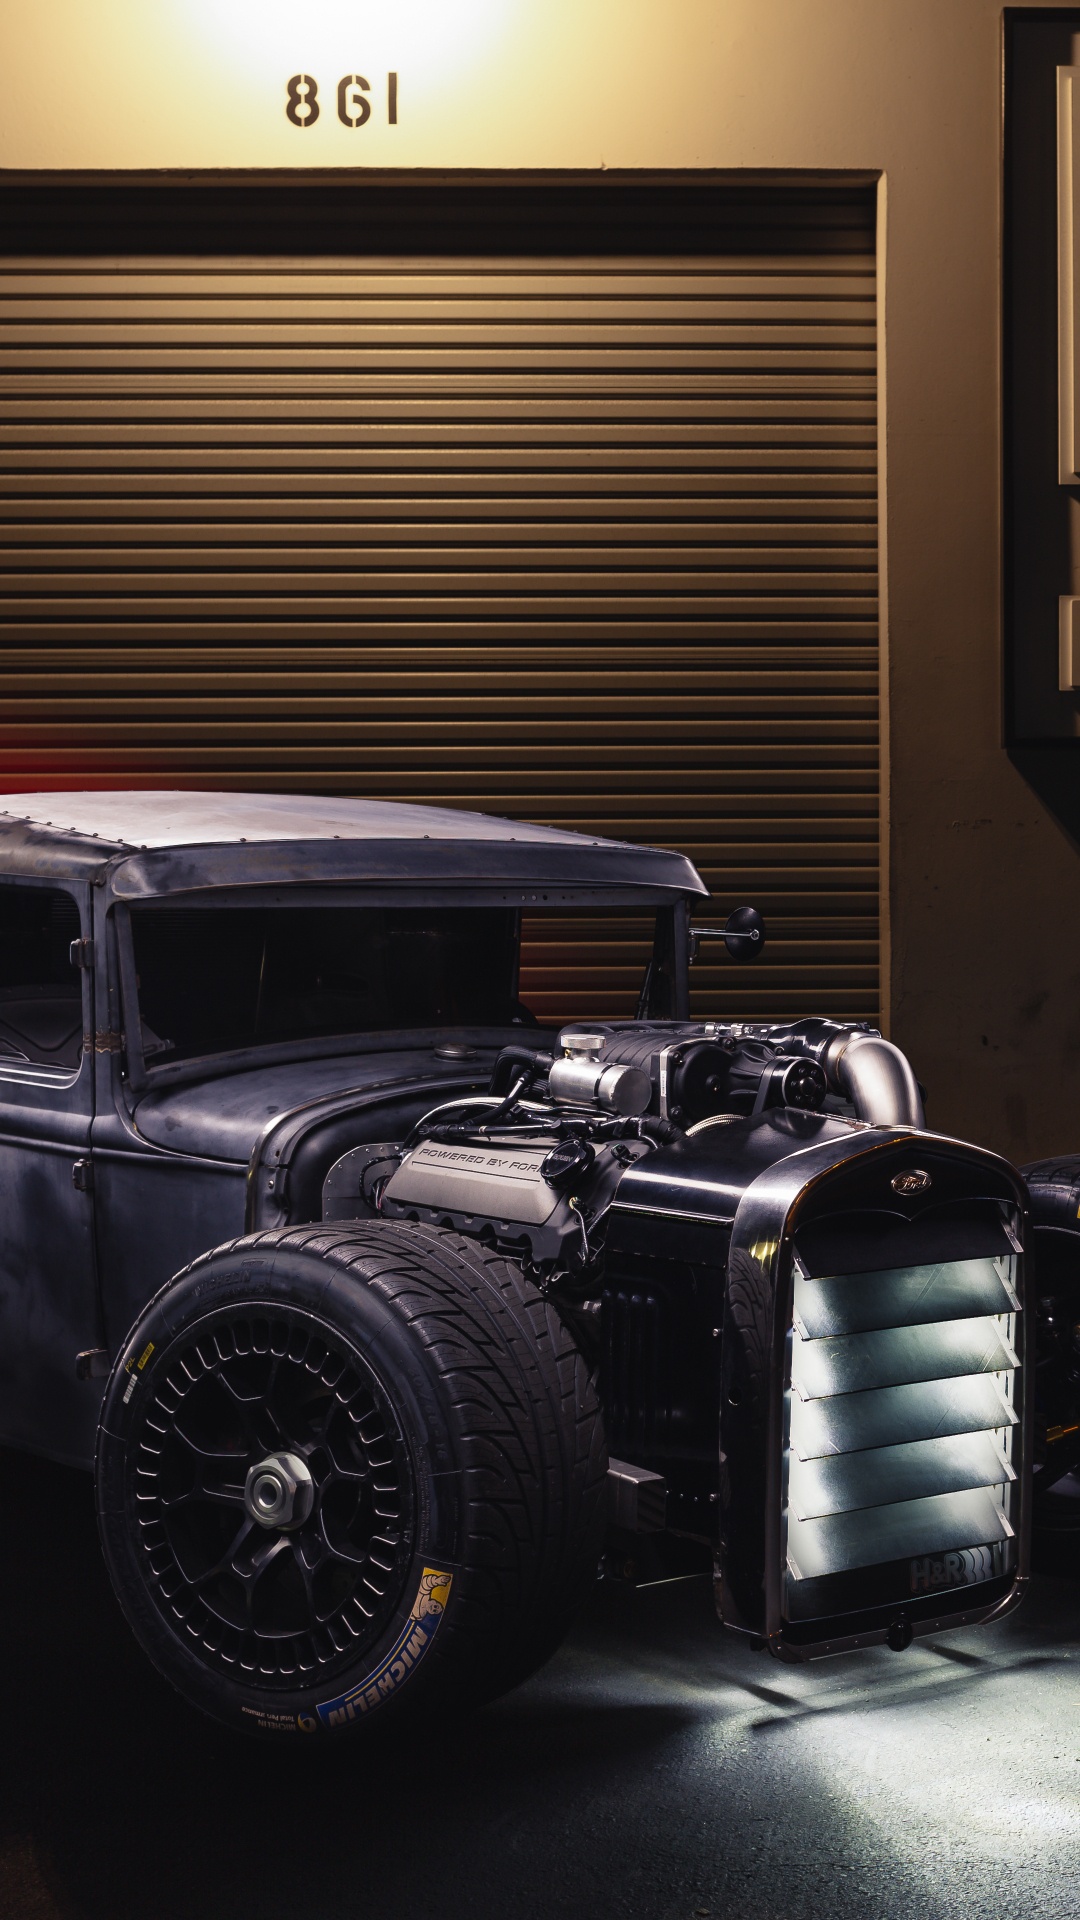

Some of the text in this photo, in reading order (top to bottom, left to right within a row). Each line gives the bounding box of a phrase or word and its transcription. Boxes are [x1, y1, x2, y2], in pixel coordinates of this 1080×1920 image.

[286, 72, 397, 128] 861
[419, 1149, 541, 1173] POWERED BY FOR
[910, 1554, 961, 1594] H&R
[328, 1625, 429, 1728] MICHELIN
[241, 1706, 295, 1722] Total Perrmance
[257, 1719, 296, 1732] MICHELIN
